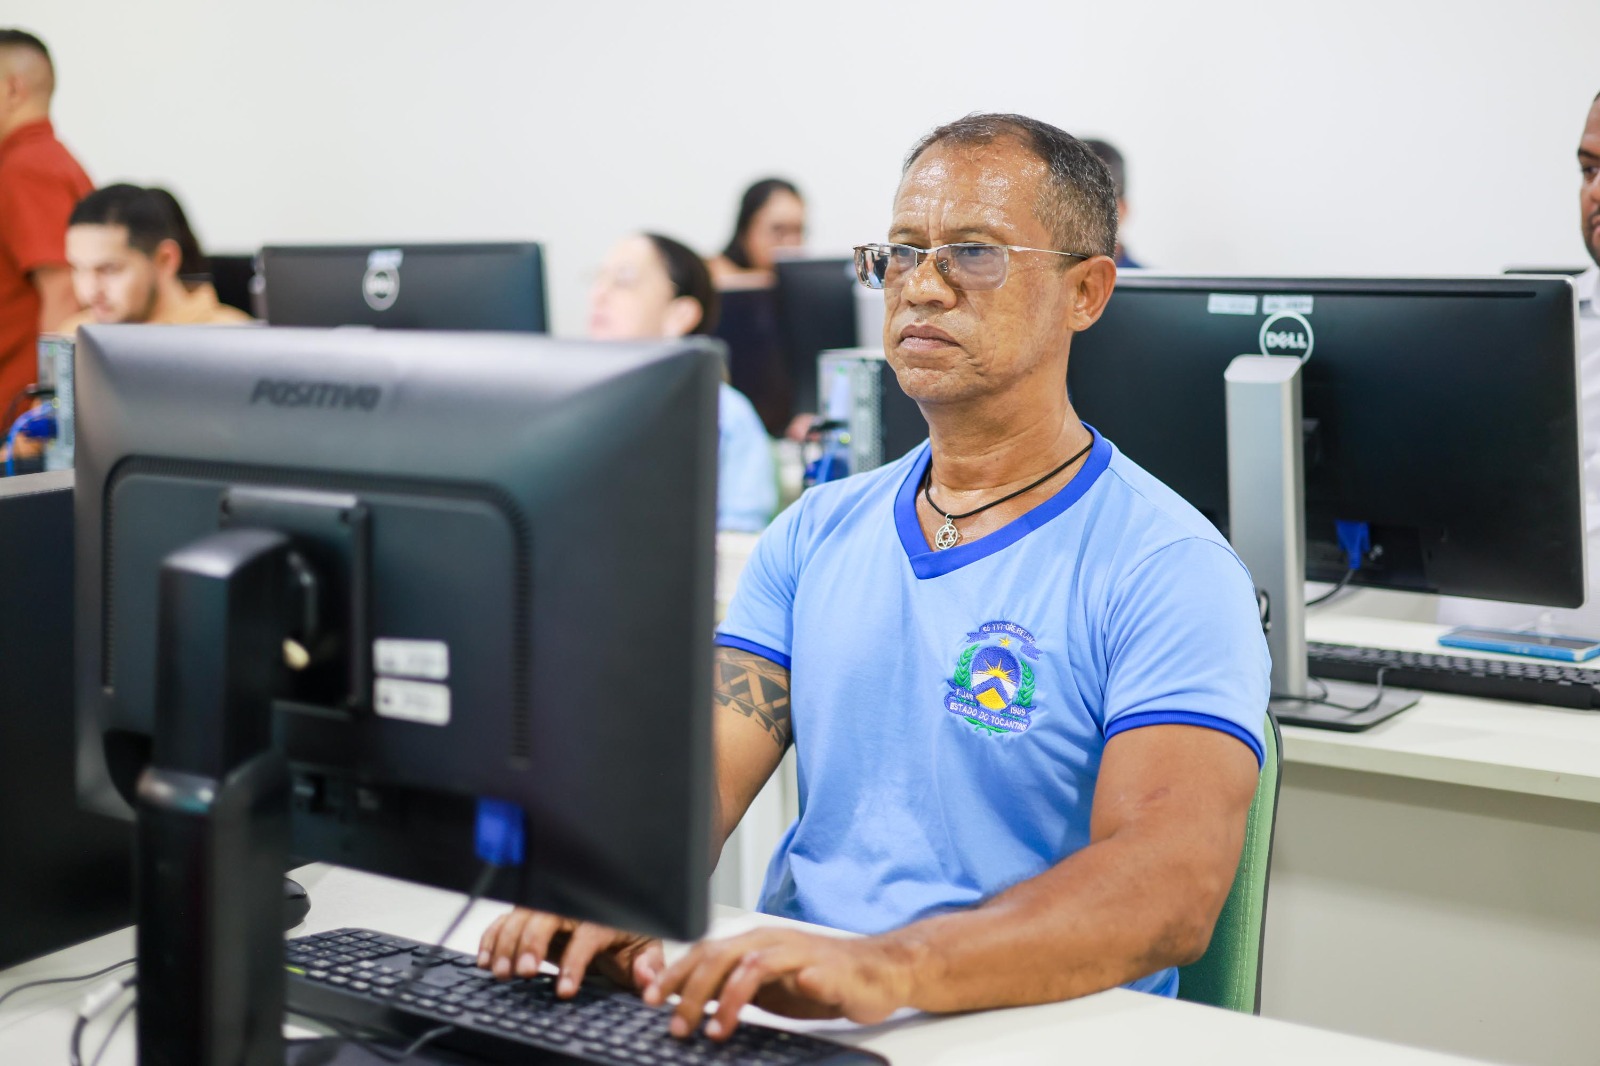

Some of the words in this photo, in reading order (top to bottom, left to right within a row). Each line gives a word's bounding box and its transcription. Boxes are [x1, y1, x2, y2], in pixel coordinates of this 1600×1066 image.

[1266, 331, 1307, 349] DELL
[249, 379, 381, 411] POSITIVO
[950, 702, 978, 717] ESTADO
[978, 711, 989, 721] DO
